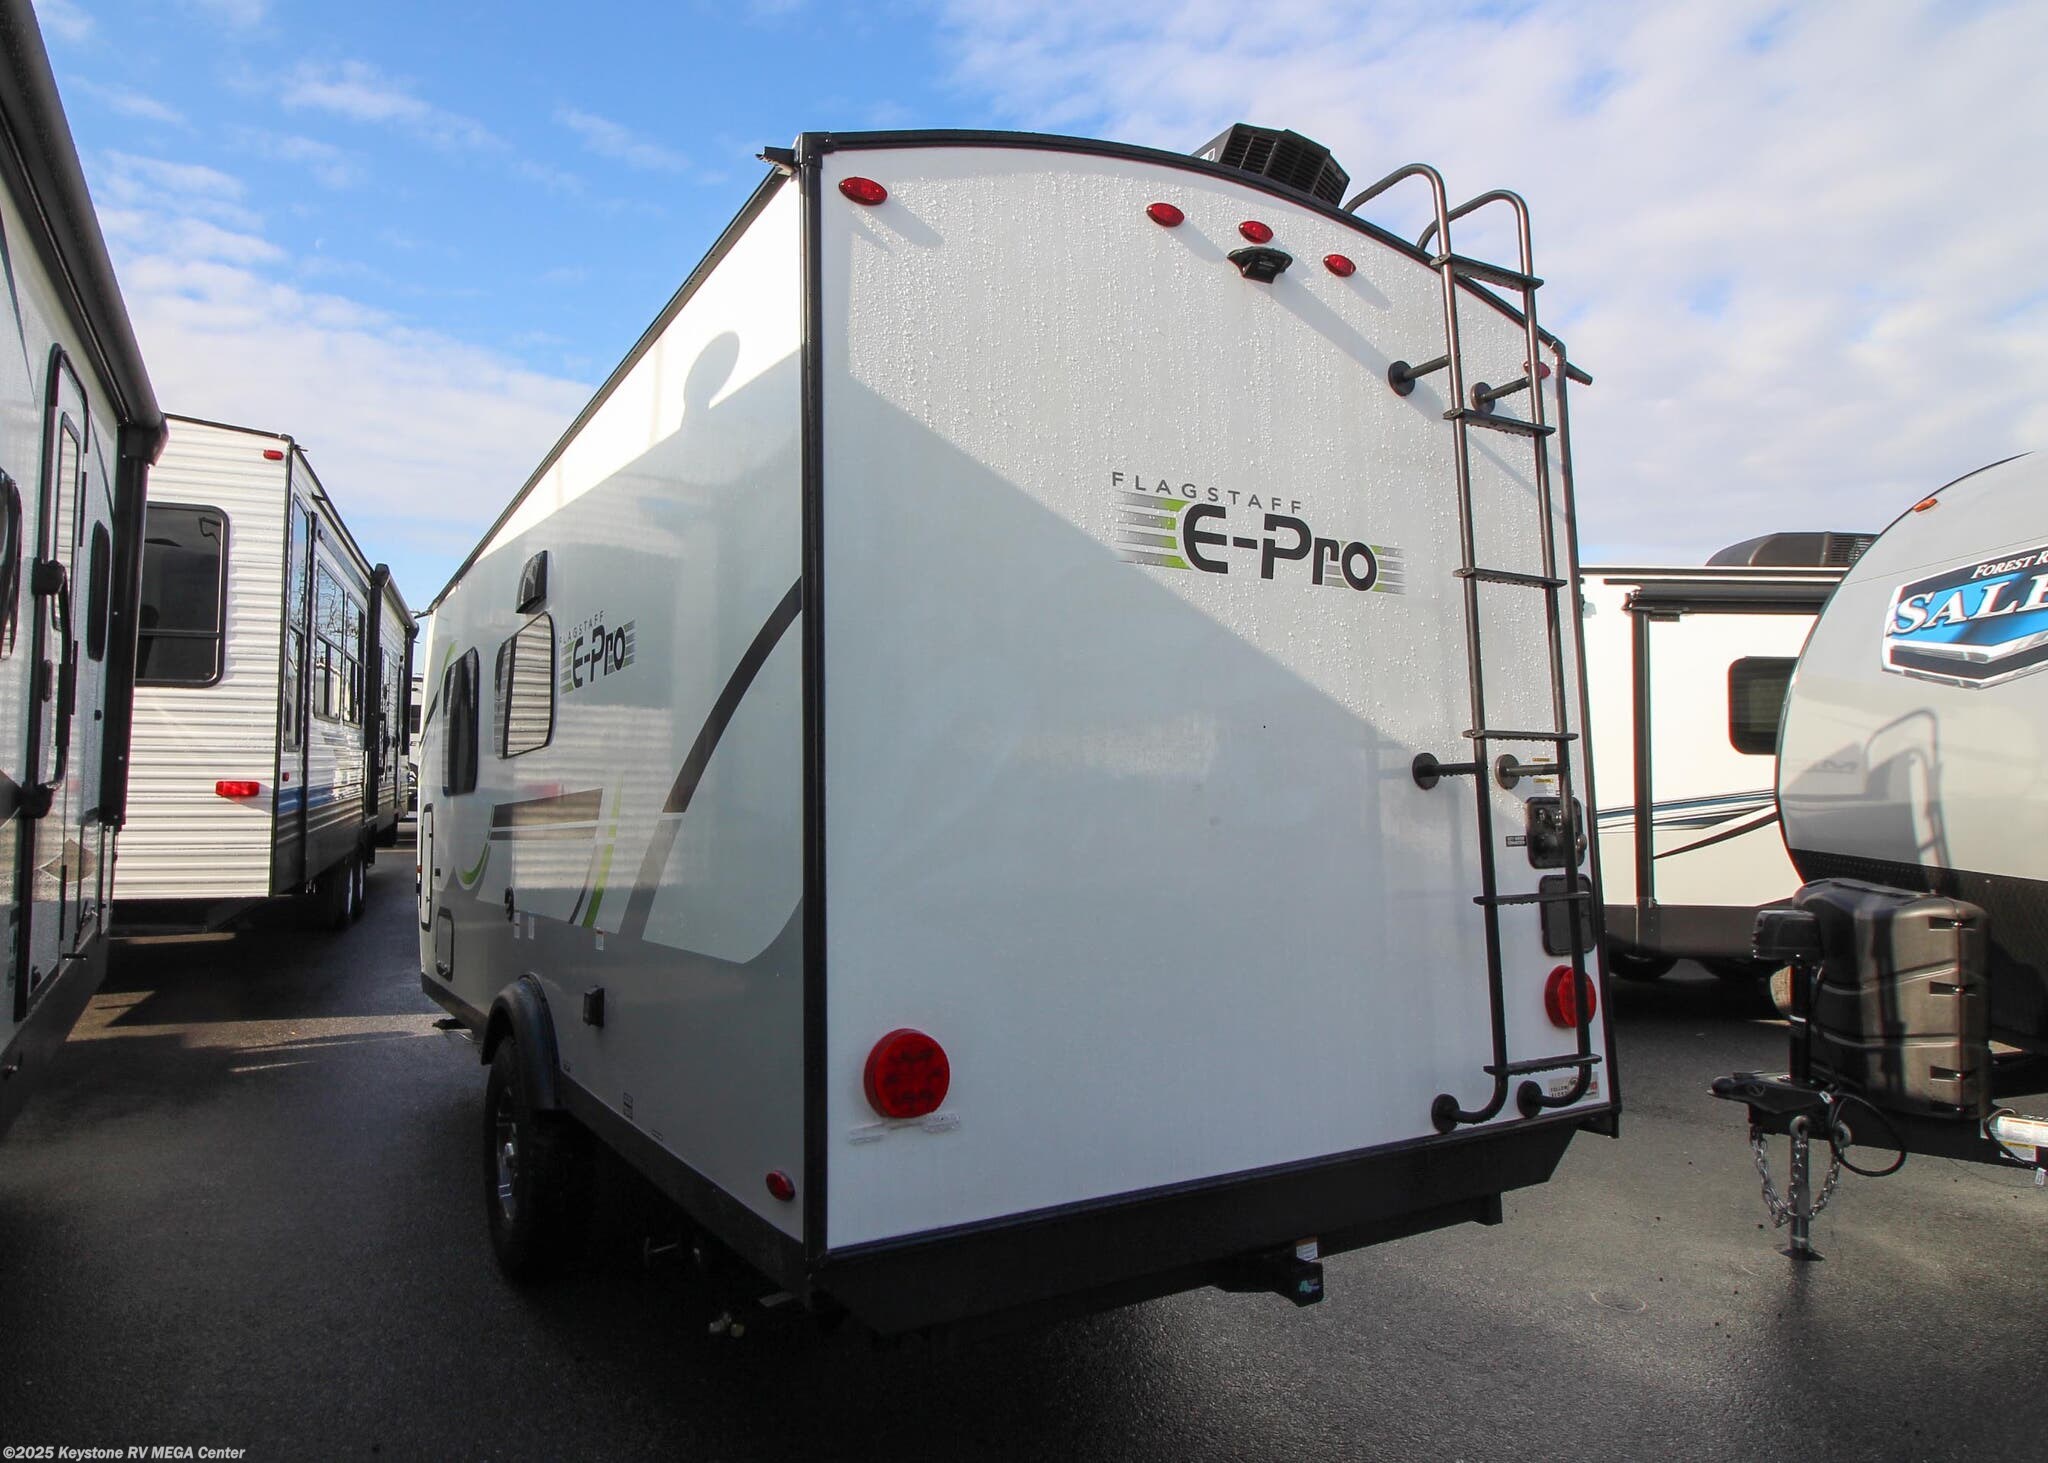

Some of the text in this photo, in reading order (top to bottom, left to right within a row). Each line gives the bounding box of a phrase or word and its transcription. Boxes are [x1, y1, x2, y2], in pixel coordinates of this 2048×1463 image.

[1112, 471, 1301, 514] FLAGSTAFF
[1183, 503, 1378, 592] E-Pro
[1970, 555, 2037, 580] FOREST
[559, 609, 604, 644] FLAGSTAFF
[572, 625, 626, 689] E-Pro
